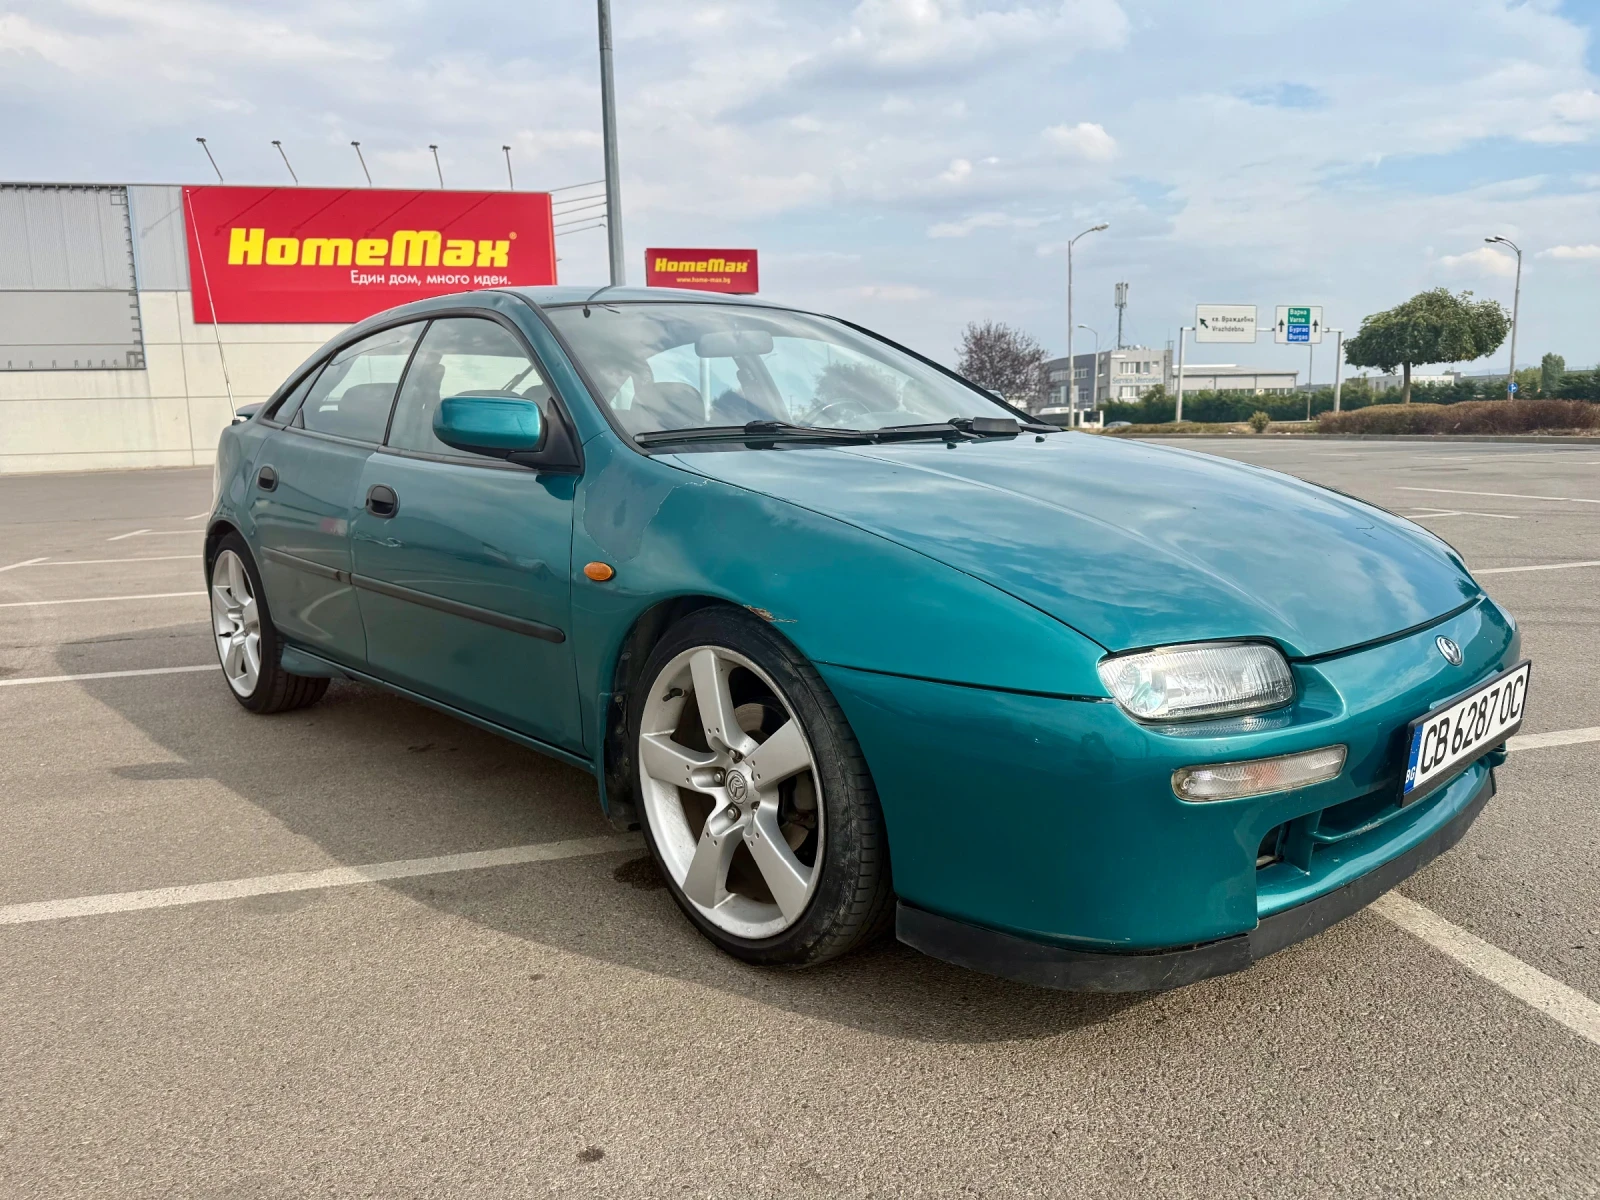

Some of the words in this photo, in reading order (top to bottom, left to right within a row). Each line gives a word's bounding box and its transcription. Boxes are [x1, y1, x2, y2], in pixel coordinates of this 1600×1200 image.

[228, 228, 510, 267] HomeMax
[654, 258, 748, 273] HomeMax
[350, 270, 385, 285] Един
[389, 273, 422, 287] дом,
[426, 274, 470, 285] много
[474, 274, 512, 287] идеи.
[1221, 315, 1255, 323] Враждебна
[1289, 308, 1308, 316] Варна
[1288, 325, 1309, 333] Бургас
[1288, 333, 1309, 341] Burgas
[1451, 687, 1500, 755] 6287
[1405, 765, 1416, 783] BG
